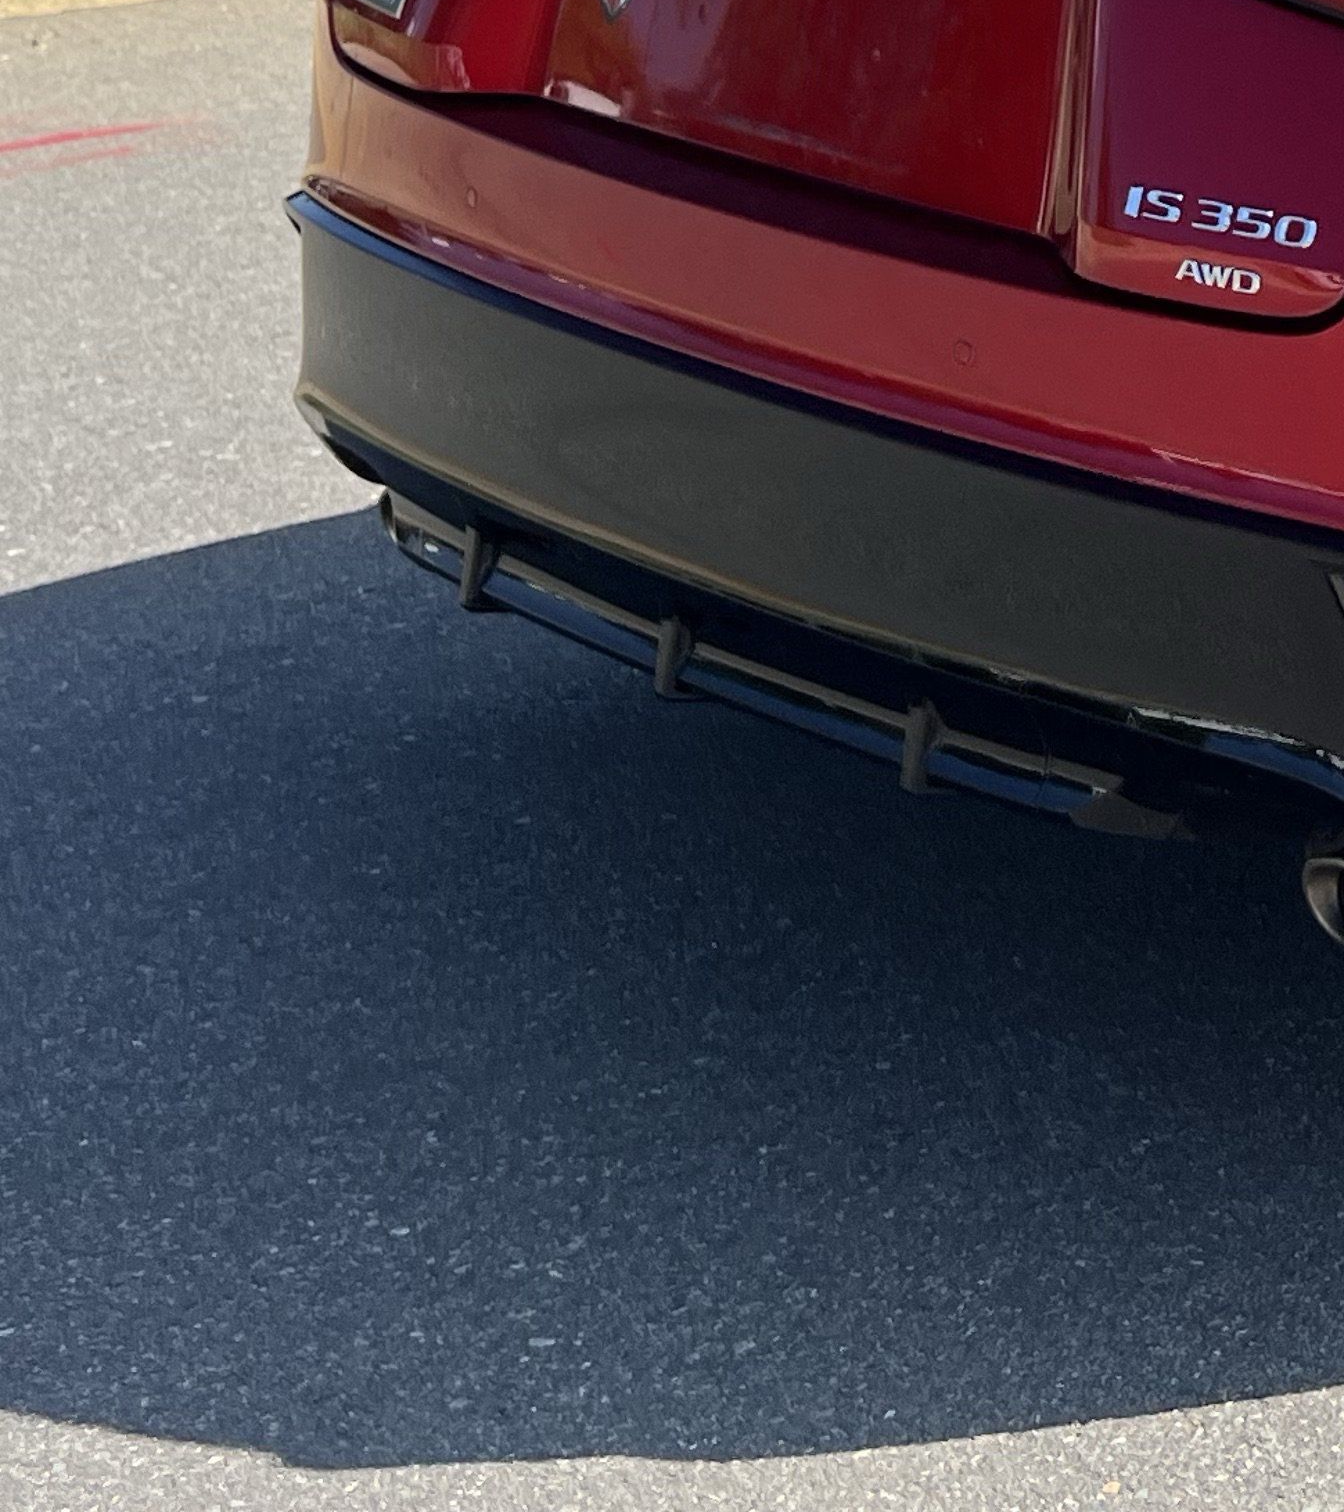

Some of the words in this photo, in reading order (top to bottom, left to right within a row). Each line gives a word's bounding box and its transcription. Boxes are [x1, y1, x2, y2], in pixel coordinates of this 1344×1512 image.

[1122, 185, 1185, 222] IS
[1191, 197, 1318, 249] 350
[1174, 258, 1262, 295] AWD
